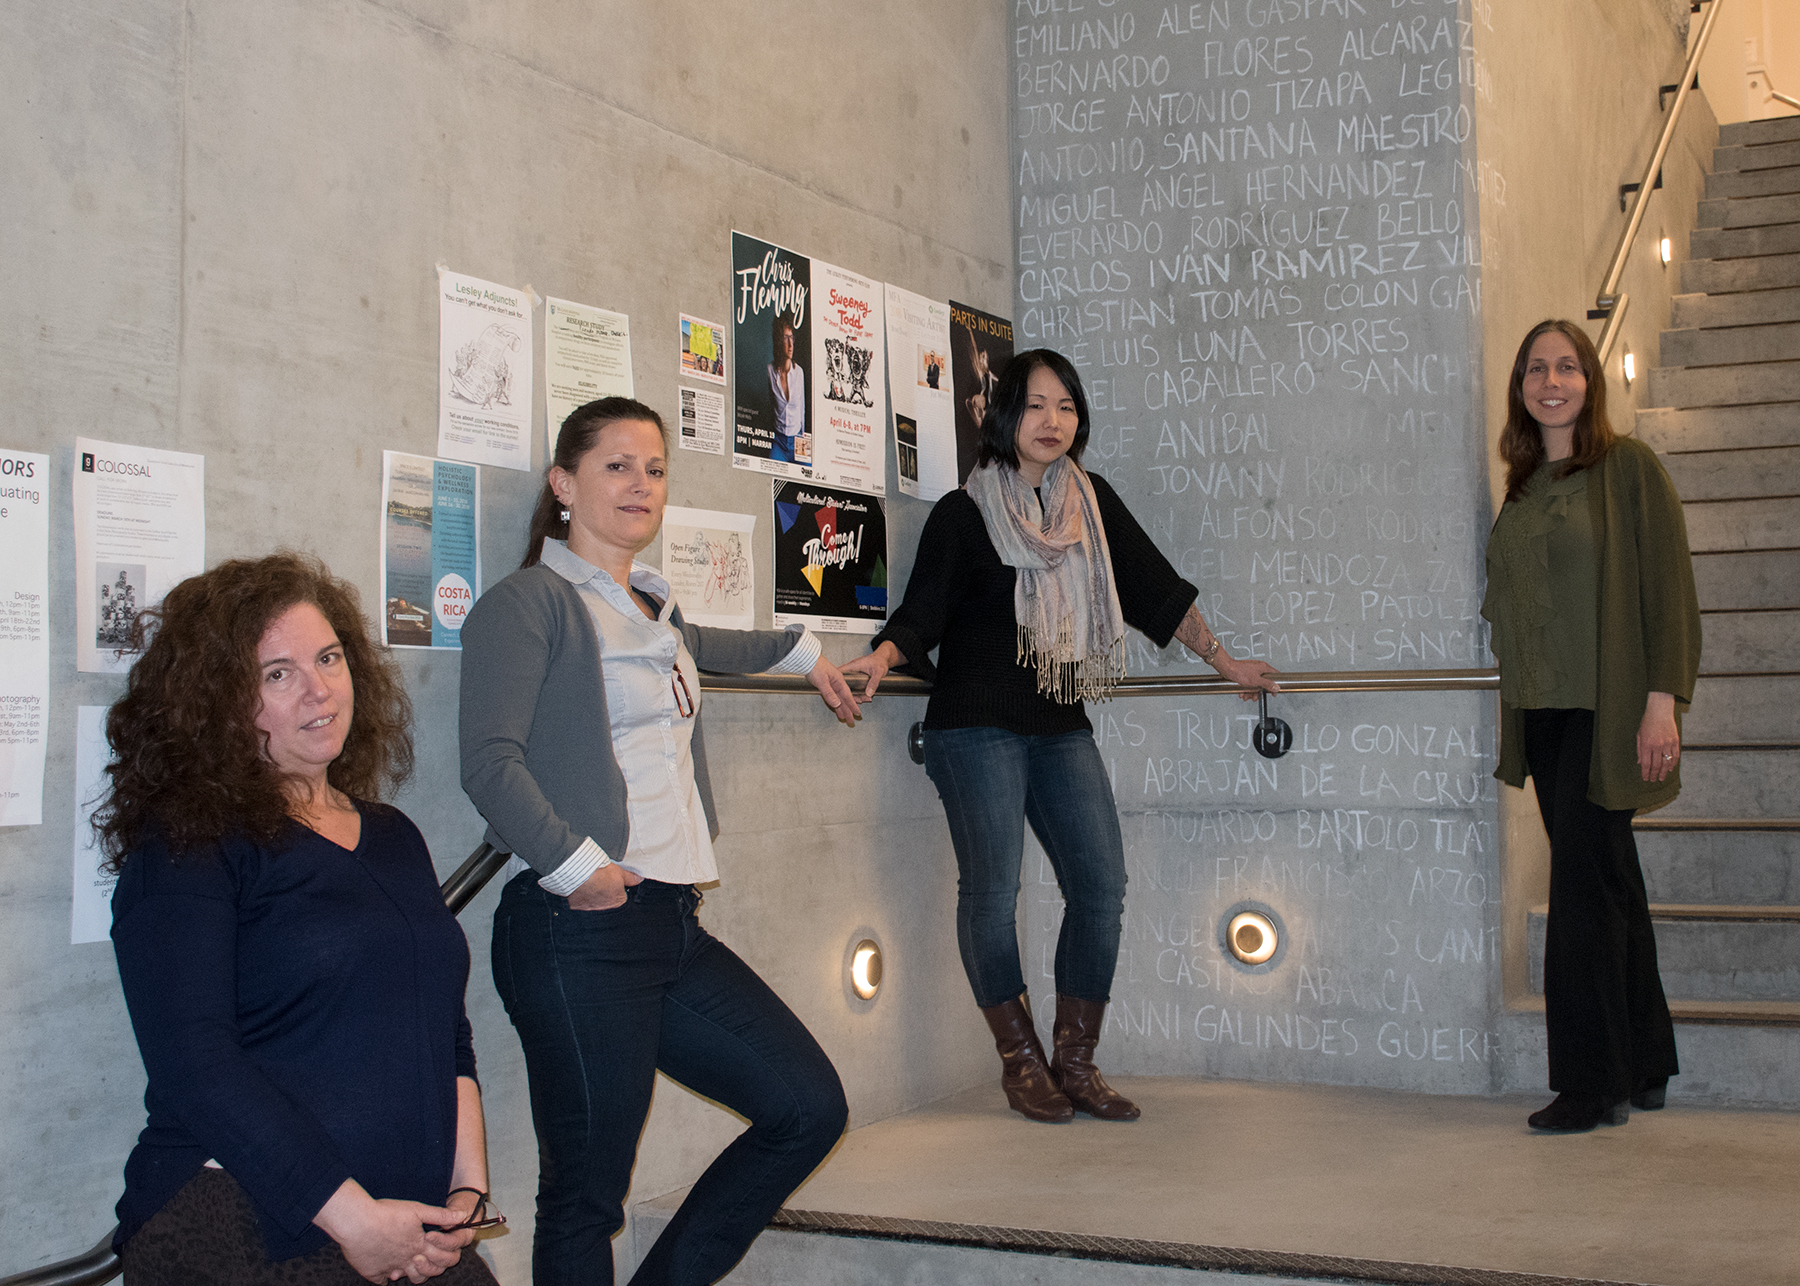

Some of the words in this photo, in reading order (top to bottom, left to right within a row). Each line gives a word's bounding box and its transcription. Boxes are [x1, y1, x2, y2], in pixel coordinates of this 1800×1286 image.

[1016, 12, 1135, 58] EMILIANO
[1157, 0, 1230, 38] ALEN
[1016, 54, 1170, 97] BERNARDO
[1203, 36, 1313, 79] FLORES
[1339, 15, 1478, 66] ALCARAZ
[1019, 98, 1106, 139] JORGE
[1126, 88, 1250, 128] ANTONIO
[1266, 70, 1372, 115] TIZAPA
[1159, 117, 1317, 171] SANTANA
[1338, 104, 1471, 155] MAESTRO
[1020, 186, 1123, 228] MIGUEL
[1246, 160, 1433, 206] HERNANDEZ
[1019, 221, 1164, 266] EVERARDO
[1191, 203, 1349, 250] RODRÍGUEZ
[1378, 200, 1460, 242] BELLO
[762, 248, 794, 284] Chris
[1020, 259, 1131, 302] CARLOS
[1252, 241, 1427, 281] RAMIREZ
[456, 282, 482, 299] Lesley
[483, 290, 518, 308] Adjuncts!
[736, 264, 808, 330] Fleming
[828, 288, 872, 318] Sweeney
[1022, 293, 1176, 339] CHRISTIAN
[1189, 277, 1302, 323] TOMÁS
[1324, 279, 1418, 311] COLON
[838, 309, 864, 330] Todd
[950, 306, 977, 330] PARTS
[978, 316, 988, 333] IN
[989, 320, 1012, 342] SUITE
[1101, 334, 1160, 368] LUIS
[1178, 325, 1267, 366] LUNA
[1286, 317, 1409, 361] TORRES
[1144, 361, 1316, 410] CABALLERO
[830, 416, 842, 428] April
[860, 424, 872, 434] 7PM
[97, 460, 152, 478] COLOSSAL
[438, 466, 462, 475] HOLISTIC
[438, 472, 472, 482] PSYCHOLOGY
[444, 480, 469, 489] WELLNESS
[1147, 457, 1287, 500] JOVANY
[438, 487, 474, 496] EXPLORATION
[821, 524, 848, 550] Come
[1199, 502, 1337, 542] ALFONSO
[670, 542, 684, 554] Open
[684, 544, 700, 555] Figure
[671, 554, 694, 567] Drawing
[802, 524, 864, 580] Through!
[1250, 549, 1412, 590] MENDOZA
[14, 591, 40, 602] Design
[438, 586, 471, 600] COSTA
[444, 604, 466, 616] RICA
[1144, 752, 1278, 797] ABRAJÁN
[1300, 763, 1338, 798] DE
[1359, 764, 1402, 799] LA
[1296, 808, 1419, 854] BARTOLO
[1195, 1004, 1358, 1056] GALINDES
